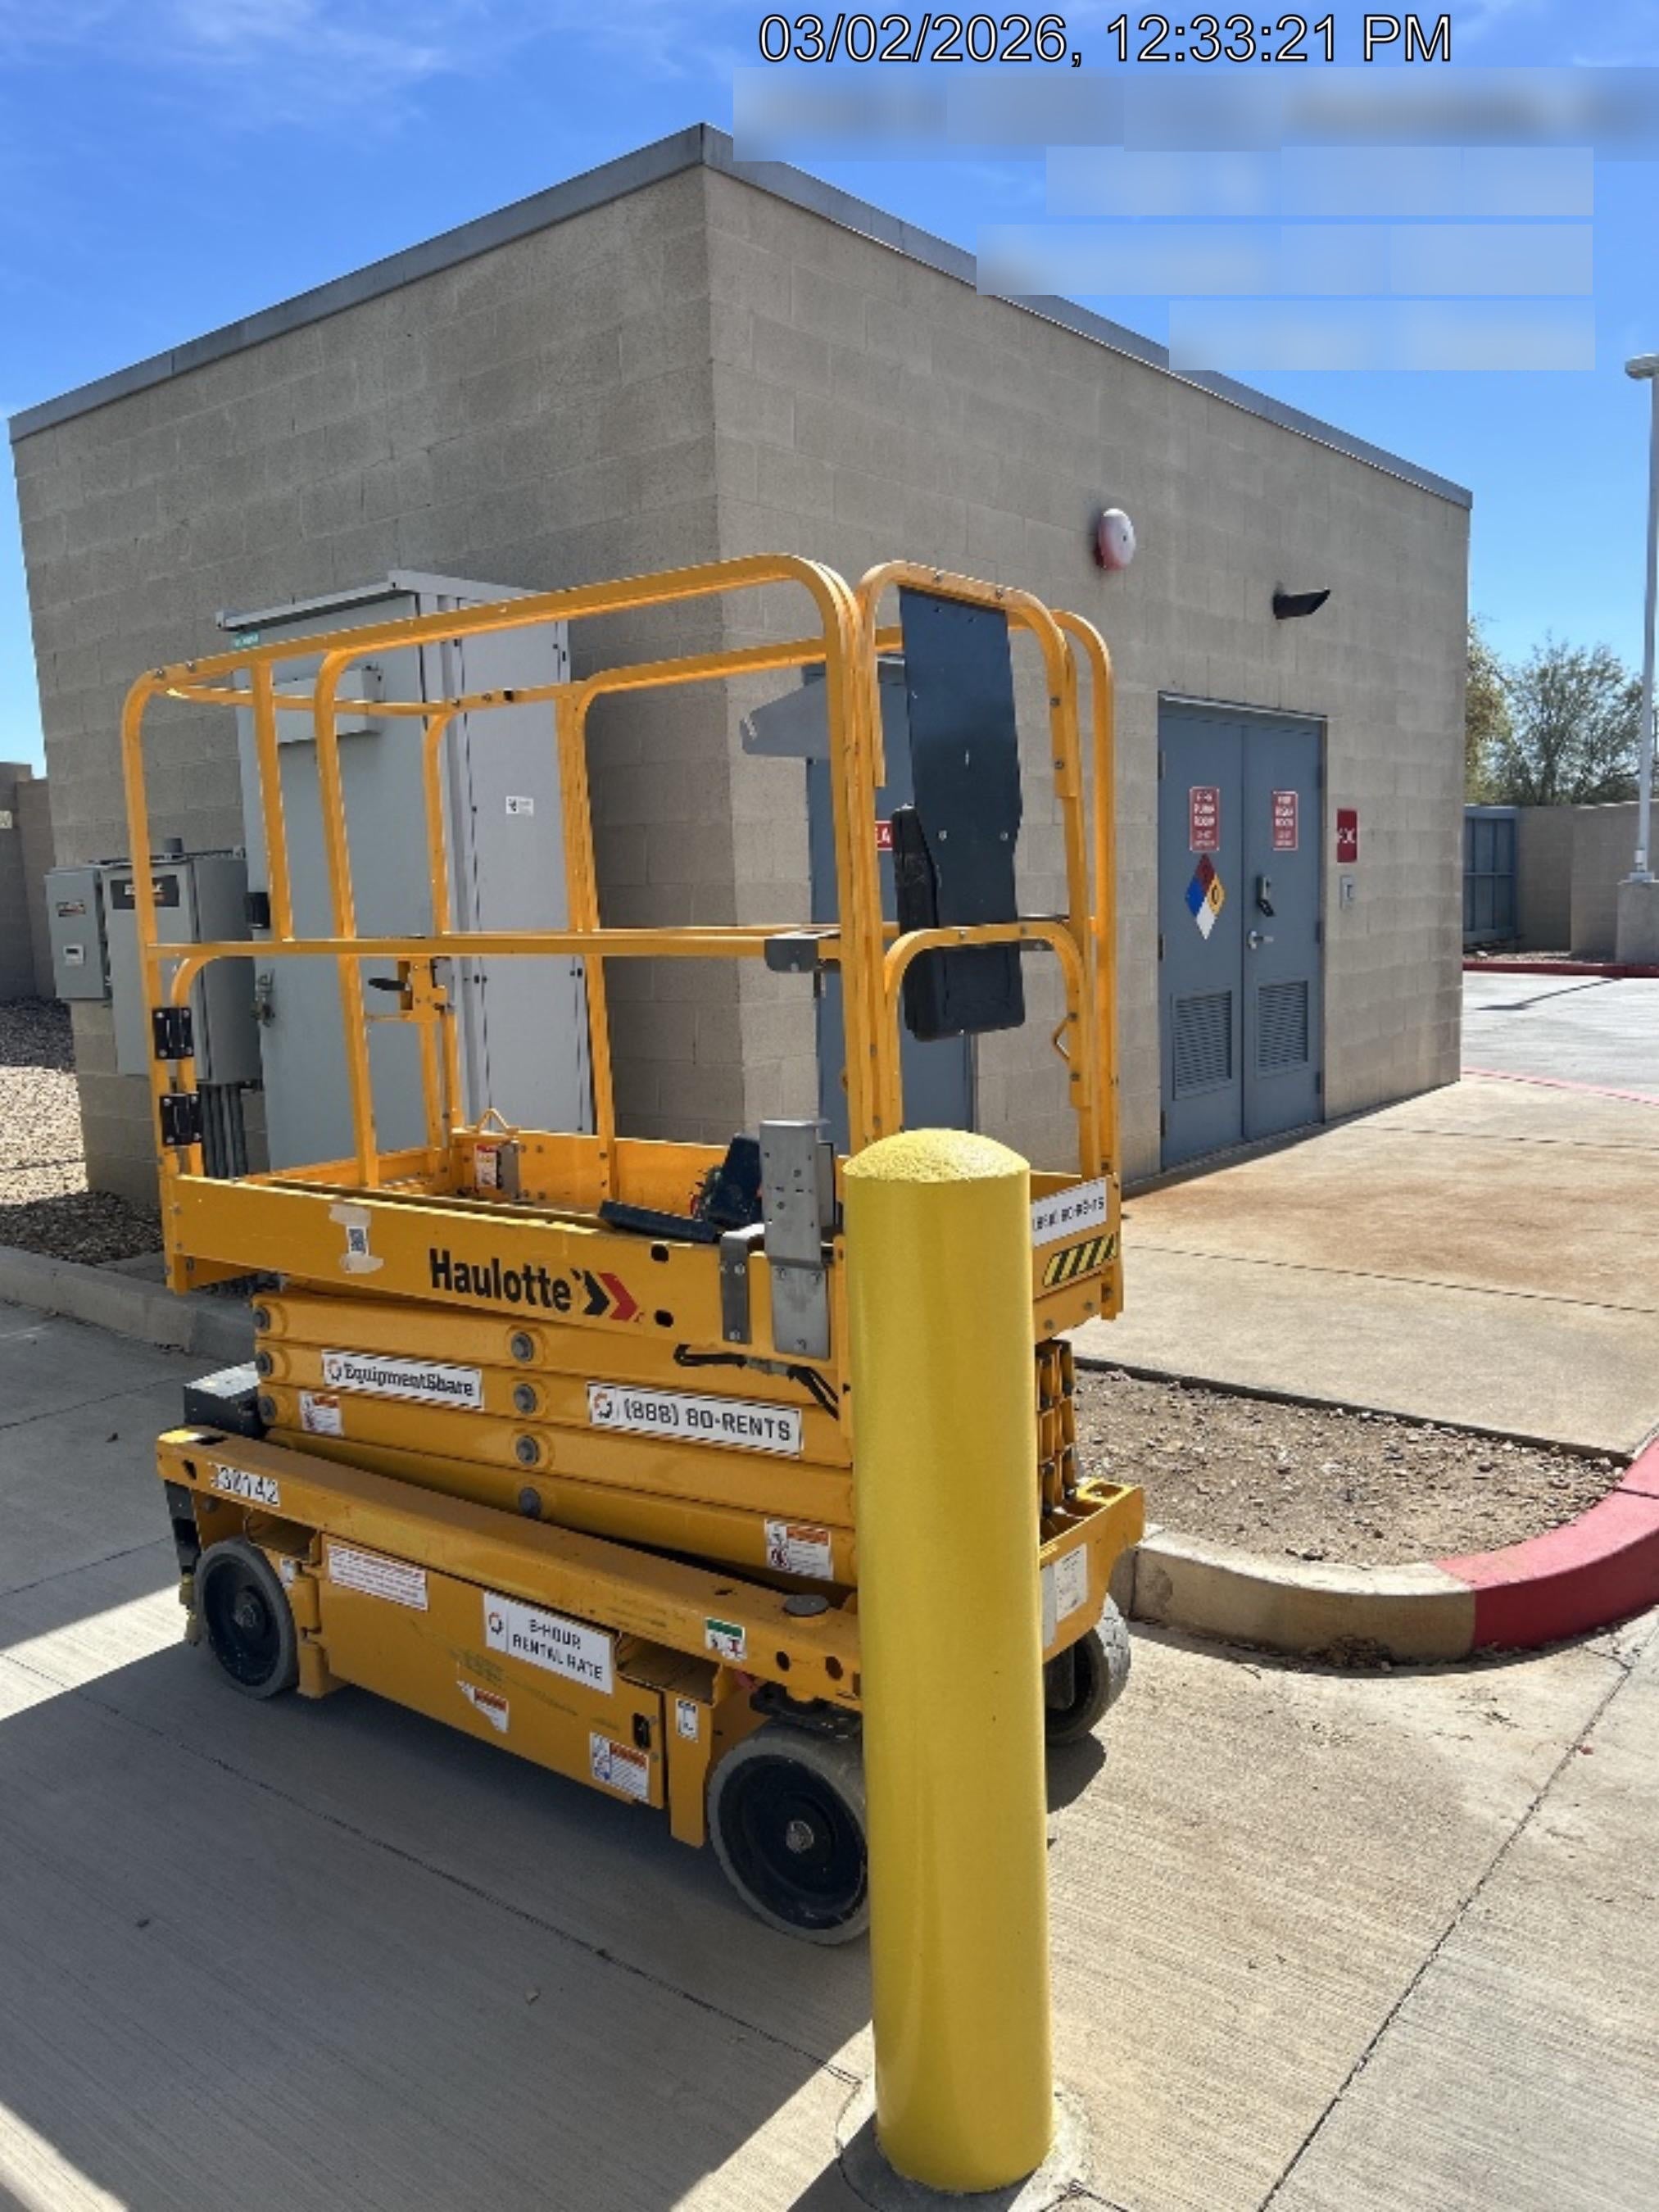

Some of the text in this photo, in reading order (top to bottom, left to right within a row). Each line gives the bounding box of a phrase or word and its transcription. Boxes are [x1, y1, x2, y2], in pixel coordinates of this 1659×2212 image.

[429, 1248, 571, 1312] Haulotte
[343, 1362, 474, 1396] EquipmentShare
[623, 1398, 790, 1440] (888) 80-RENTS
[512, 1634, 564, 1665] RENTAL
